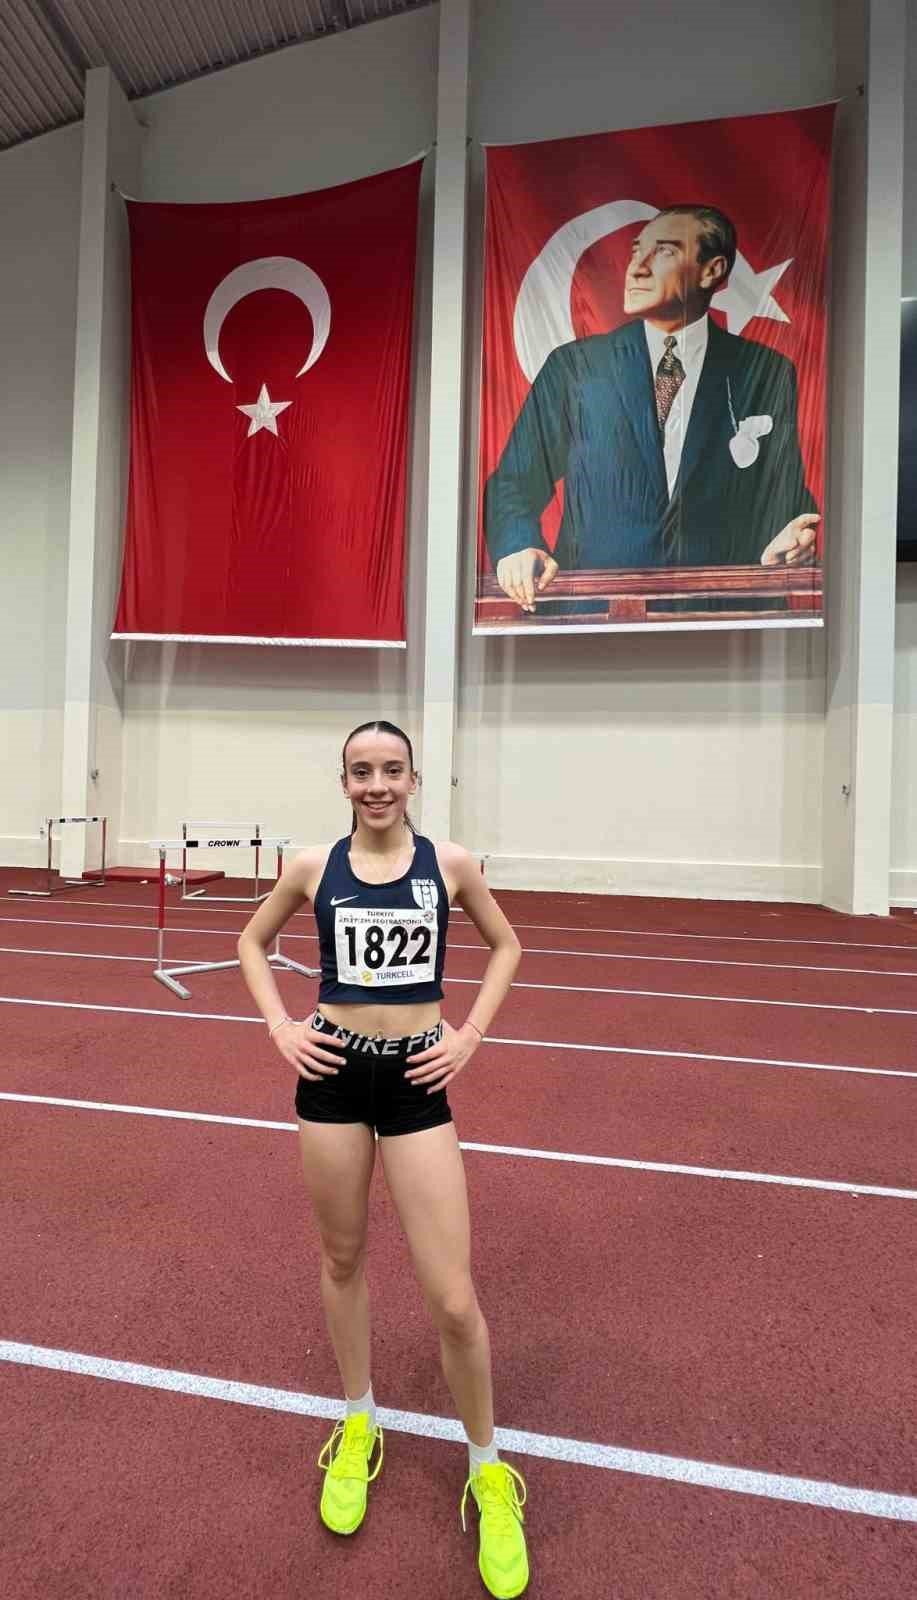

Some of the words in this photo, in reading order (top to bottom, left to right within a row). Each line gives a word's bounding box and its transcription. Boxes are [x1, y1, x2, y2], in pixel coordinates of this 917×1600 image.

[207, 839, 241, 848] CROWN
[410, 878, 436, 886] ENKA
[344, 925, 432, 970] 1822
[375, 969, 415, 980] TURKCELL
[332, 1025, 400, 1055] NIKE
